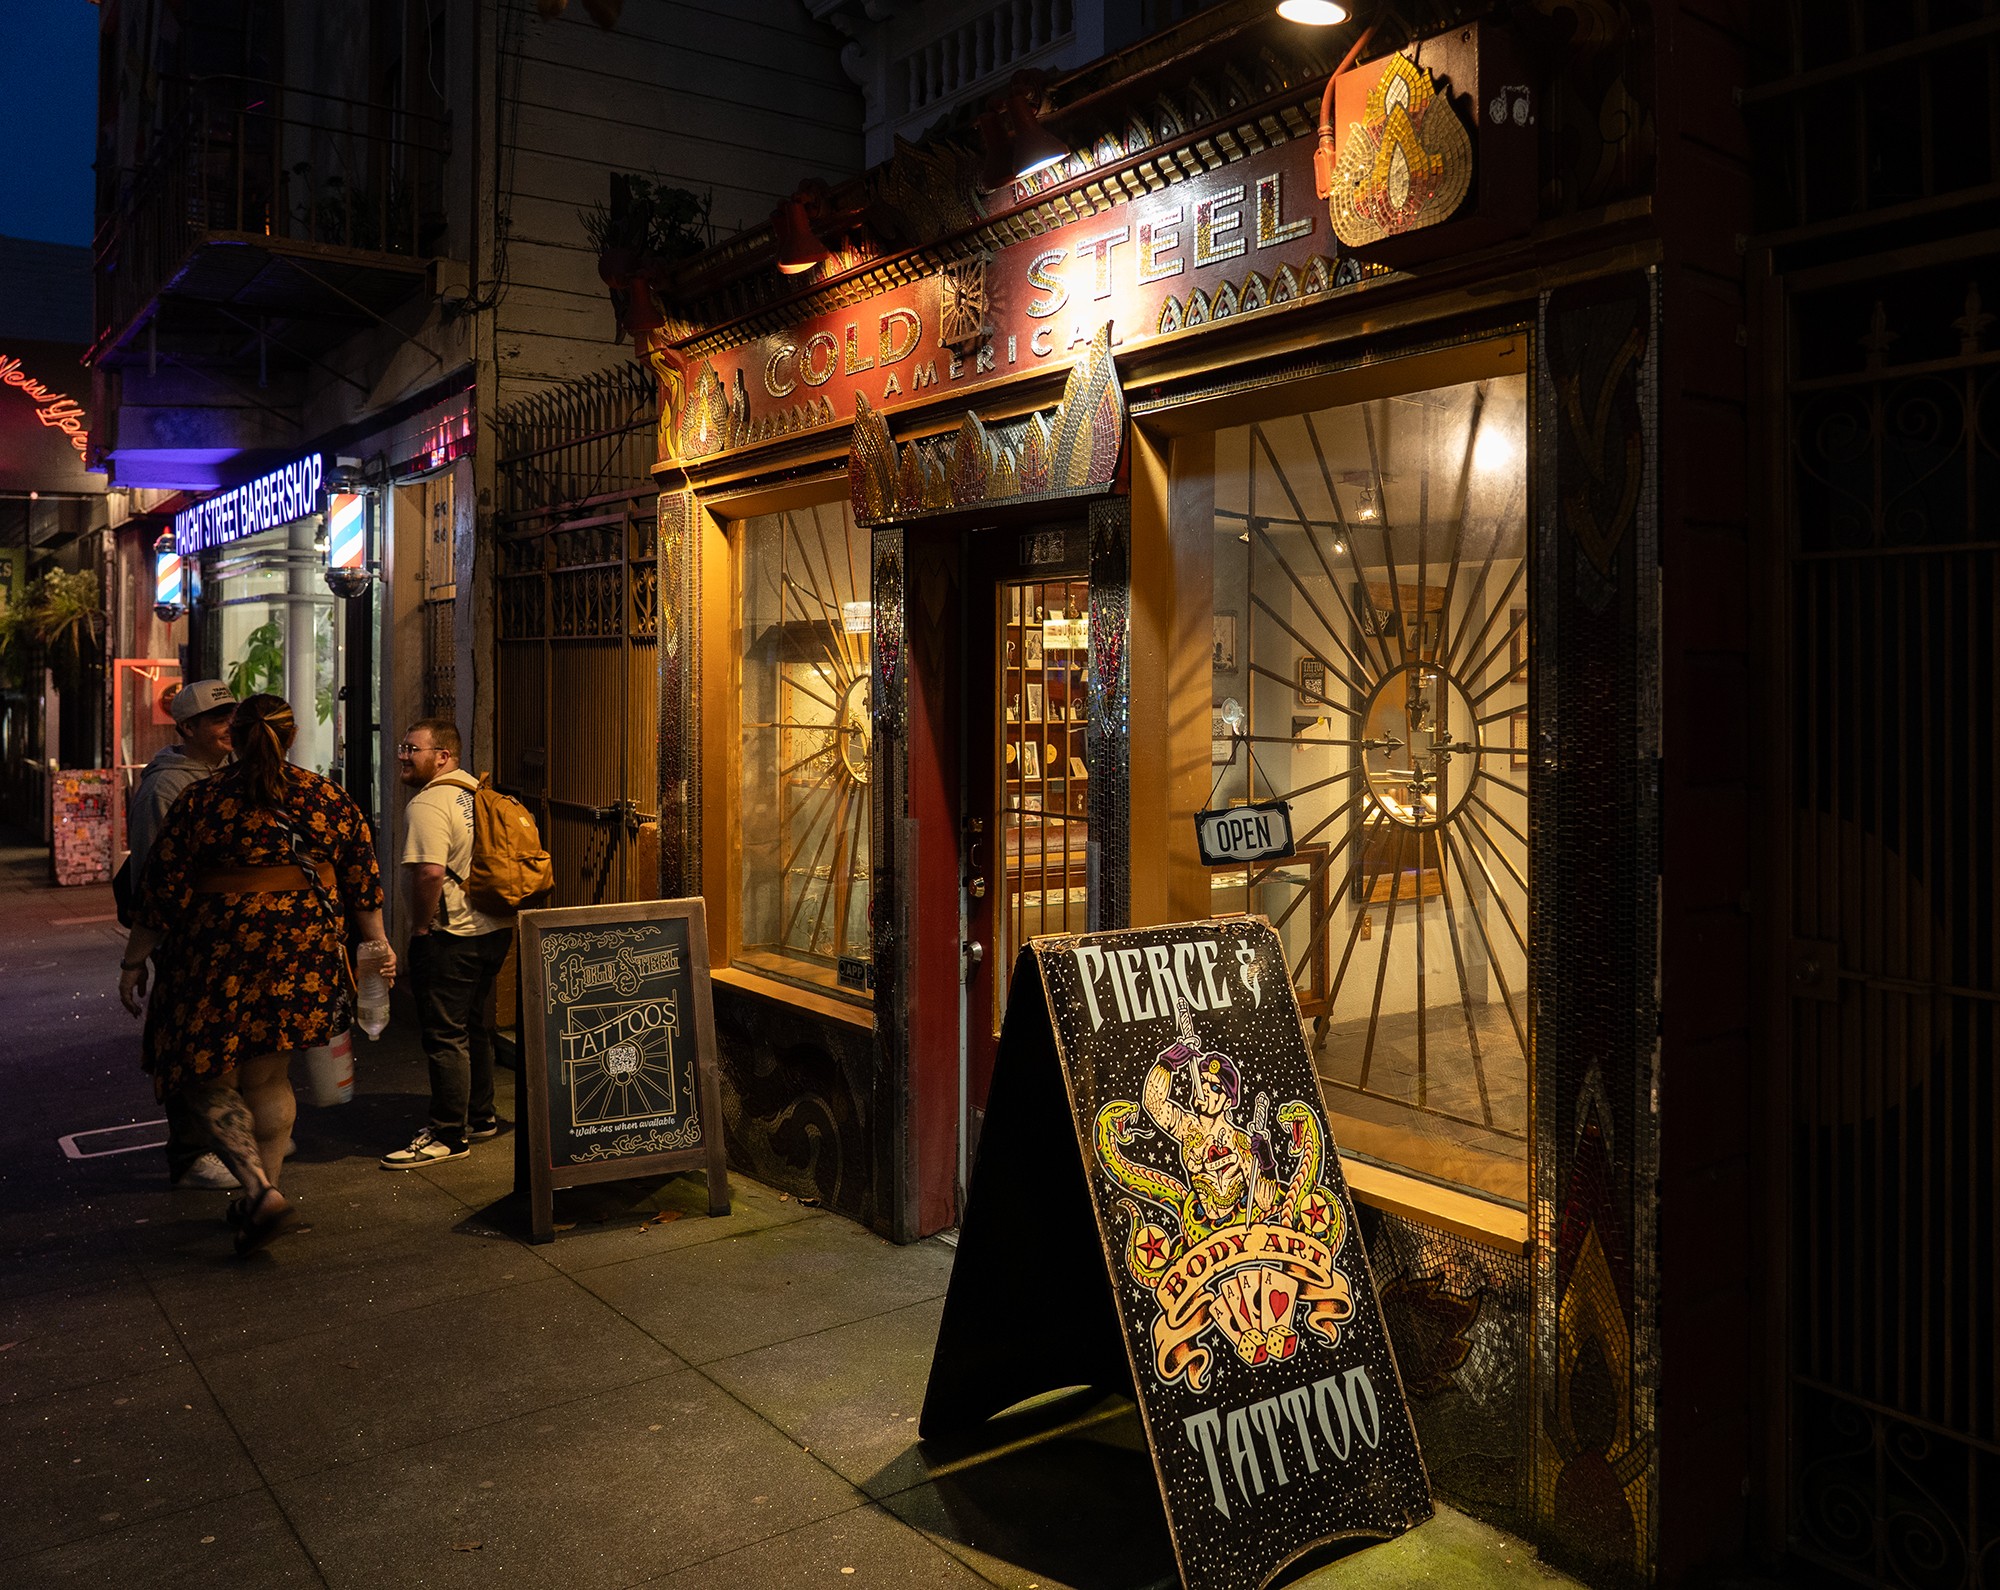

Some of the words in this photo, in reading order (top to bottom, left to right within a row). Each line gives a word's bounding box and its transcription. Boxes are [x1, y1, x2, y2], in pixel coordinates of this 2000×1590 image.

[764, 307, 922, 398] COLD
[1026, 172, 1313, 318] STEEL
[176, 503, 204, 556] HAIGHT
[204, 489, 239, 548] STREET
[240, 452, 322, 536] BARBERSHOP
[1216, 815, 1273, 853] OPEN
[846, 963, 863, 978] APP
[1073, 940, 1233, 1033] PIERCE
[561, 1002, 676, 1060] TATTOOS
[614, 1121, 638, 1131] when
[639, 1116, 676, 1128] available
[1210, 1155, 1232, 1170] LUST
[1161, 1232, 1253, 1305] BODY
[1259, 1232, 1328, 1268] ART
[1264, 1272, 1273, 1286] A
[1227, 1284, 1235, 1299] A
[1243, 1275, 1252, 1289] A
[1214, 1306, 1224, 1320] A
[1182, 1365, 1380, 1520] TATTOO
